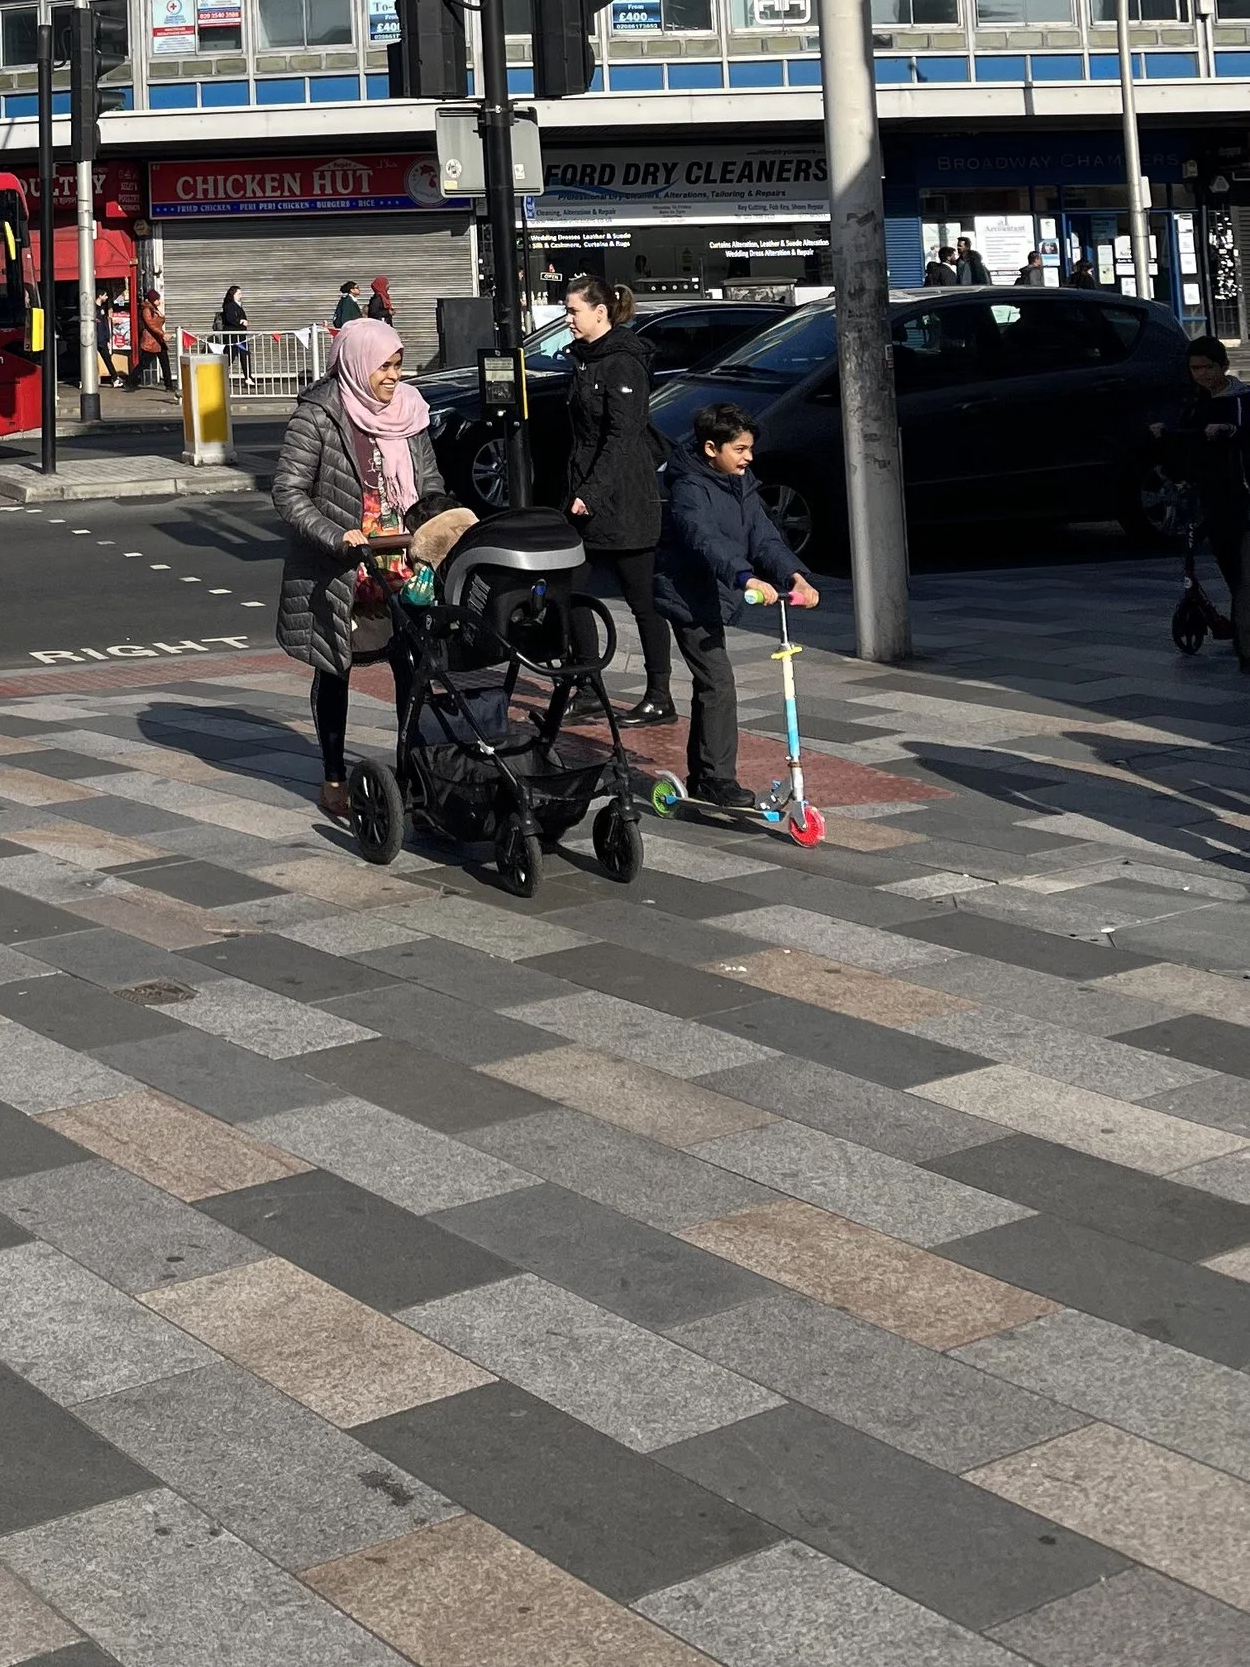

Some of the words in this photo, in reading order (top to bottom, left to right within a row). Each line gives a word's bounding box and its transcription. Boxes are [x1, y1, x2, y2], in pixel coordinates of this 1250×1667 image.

[618, 12, 647, 21] £400
[937, 155, 1051, 172] BROADWAY
[1060, 153, 1180, 169] CHAMERS
[544, 163, 615, 186] FORD
[622, 162, 678, 185] DRY
[685, 159, 828, 184] CLEANERS
[176, 173, 302, 200] CHICKEN
[312, 169, 374, 195] HUT
[664, 191, 710, 199] Alterations,
[711, 190, 740, 198] Tailoring
[756, 189, 786, 197] Repairs
[177, 205, 198, 213] FRIED
[200, 204, 231, 212] CHICKEN
[240, 203, 256, 211] PERI
[277, 201, 309, 210] CHICKEN
[316, 199, 350, 208] BURGERS
[358, 199, 375, 207] RICE
[725, 250, 749, 258] Wedding
[29, 636, 249, 665] RIGHT
